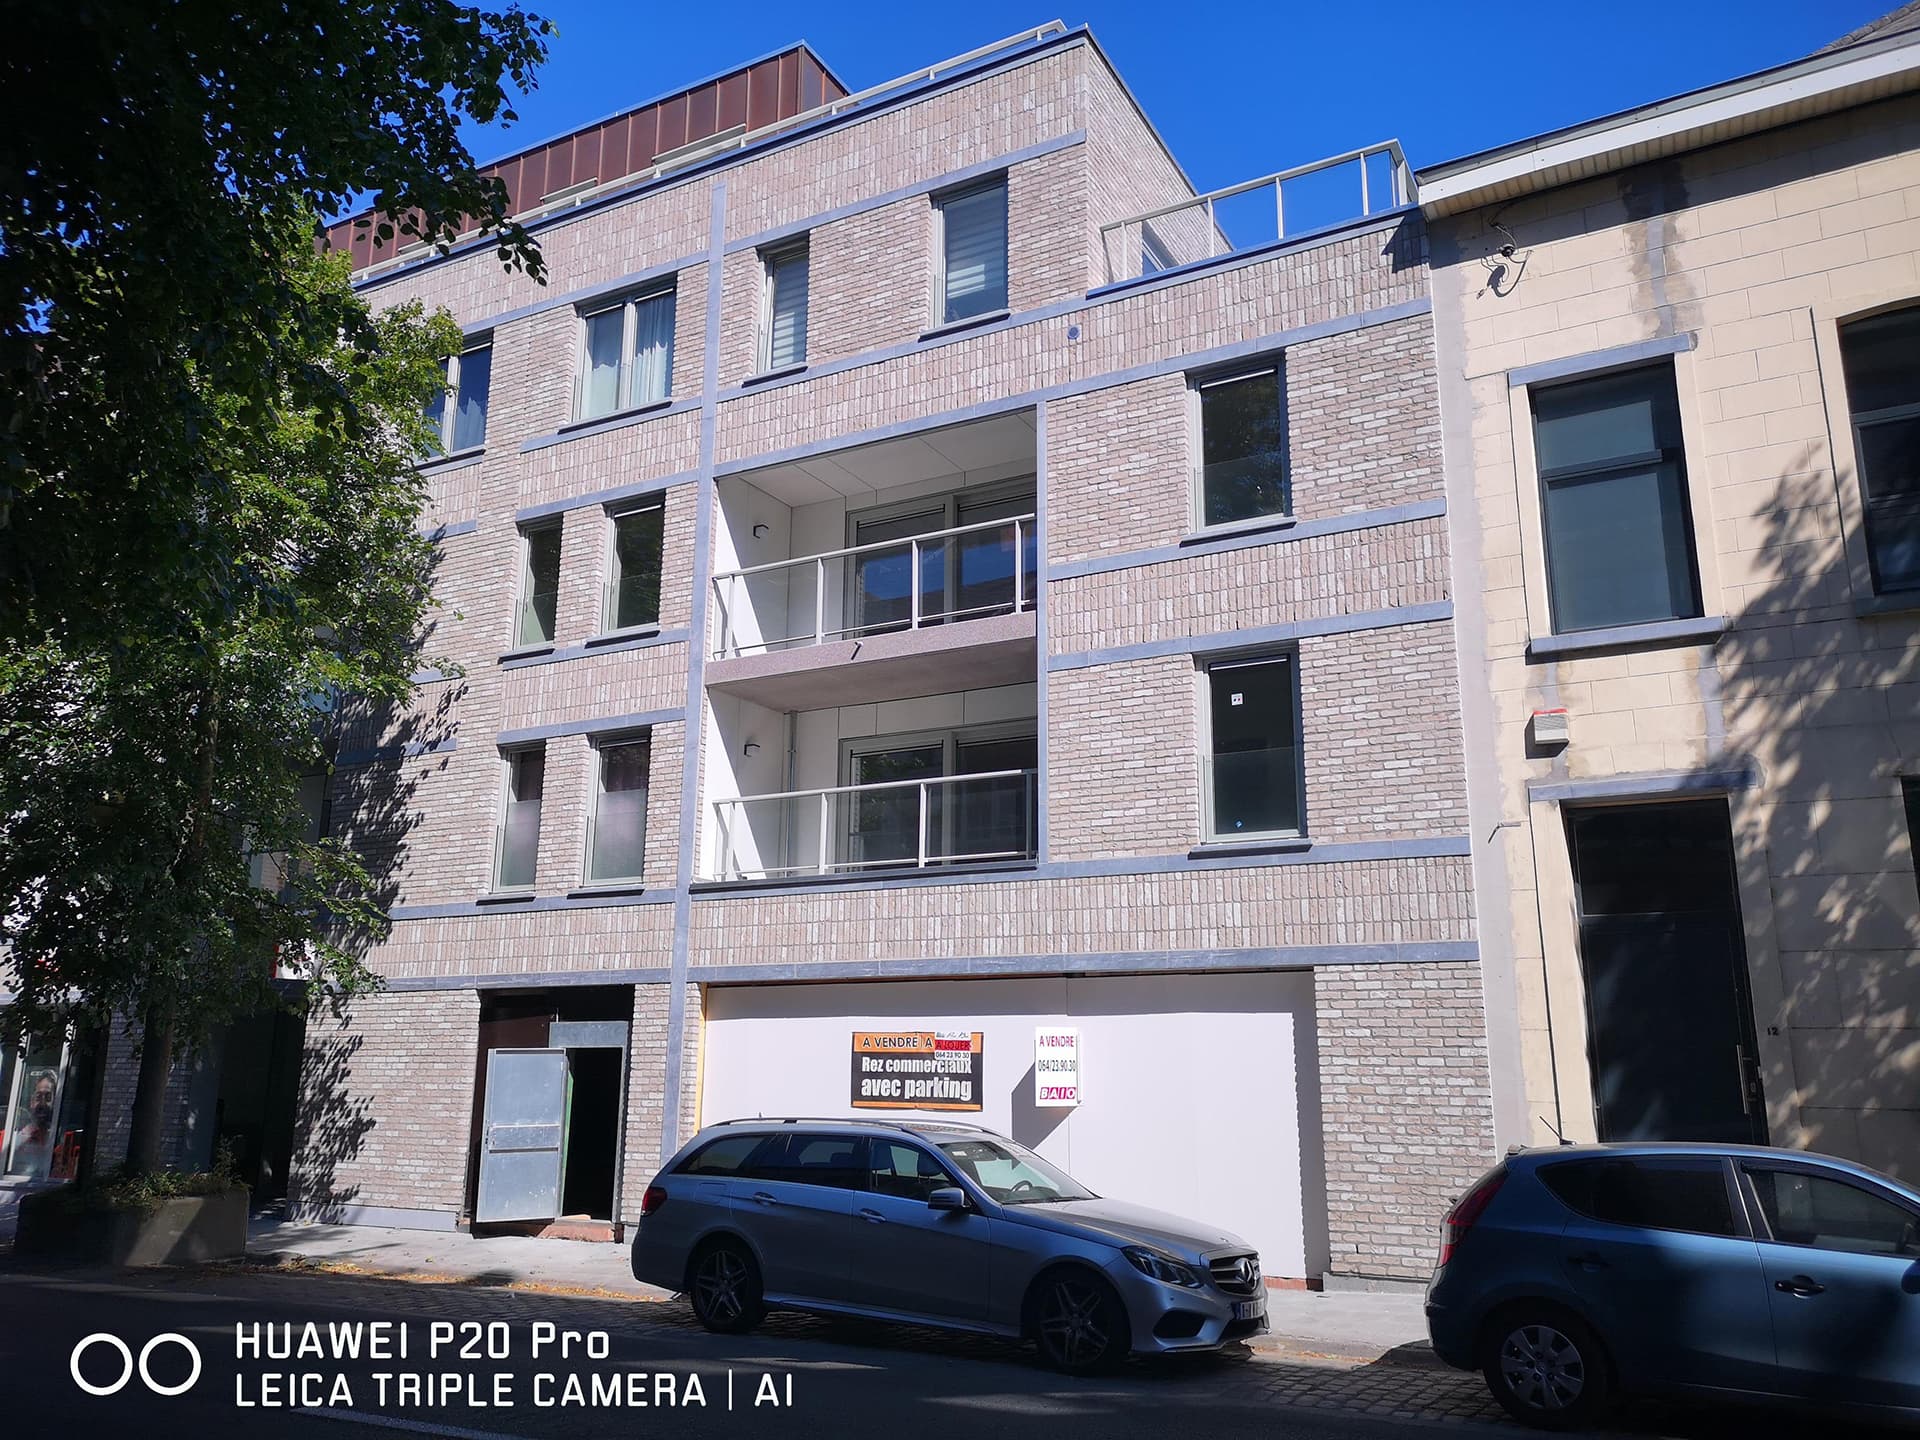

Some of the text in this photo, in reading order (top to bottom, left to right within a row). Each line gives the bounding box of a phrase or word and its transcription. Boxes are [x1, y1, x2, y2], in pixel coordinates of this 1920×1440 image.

[1767, 1026, 1779, 1036] 12
[863, 1037, 933, 1047] A VENDRE A
[1039, 1036, 1074, 1047] A VENDRE
[862, 1056, 972, 1074] Rez commerciaux
[1038, 1059, 1077, 1072] 064/23.90.30
[861, 1077, 972, 1101] avec parking
[1040, 1087, 1077, 1100] BAIO
